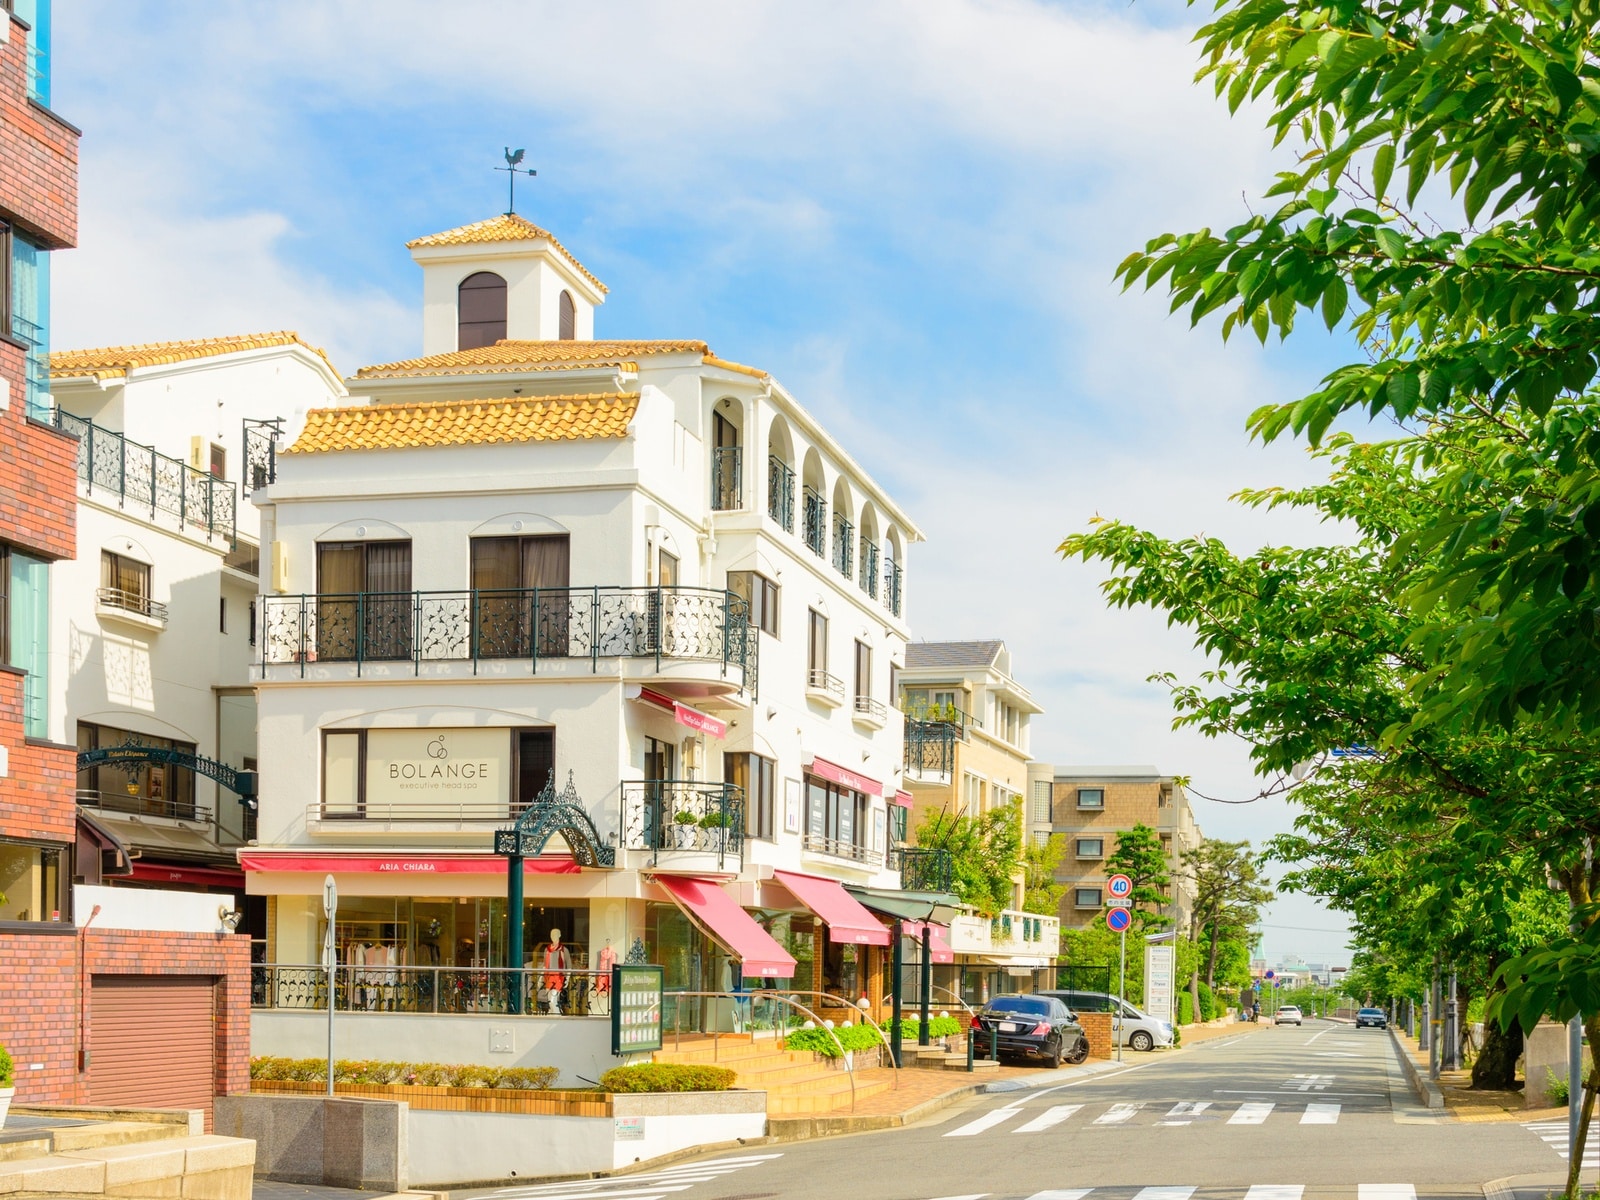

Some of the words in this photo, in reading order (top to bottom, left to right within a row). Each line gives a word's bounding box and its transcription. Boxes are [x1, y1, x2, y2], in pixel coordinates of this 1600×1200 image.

[389, 763, 488, 779] BOLANGE
[379, 863, 400, 871] ARIA
[402, 863, 436, 871] CHIARA
[1112, 881, 1127, 892] 40
